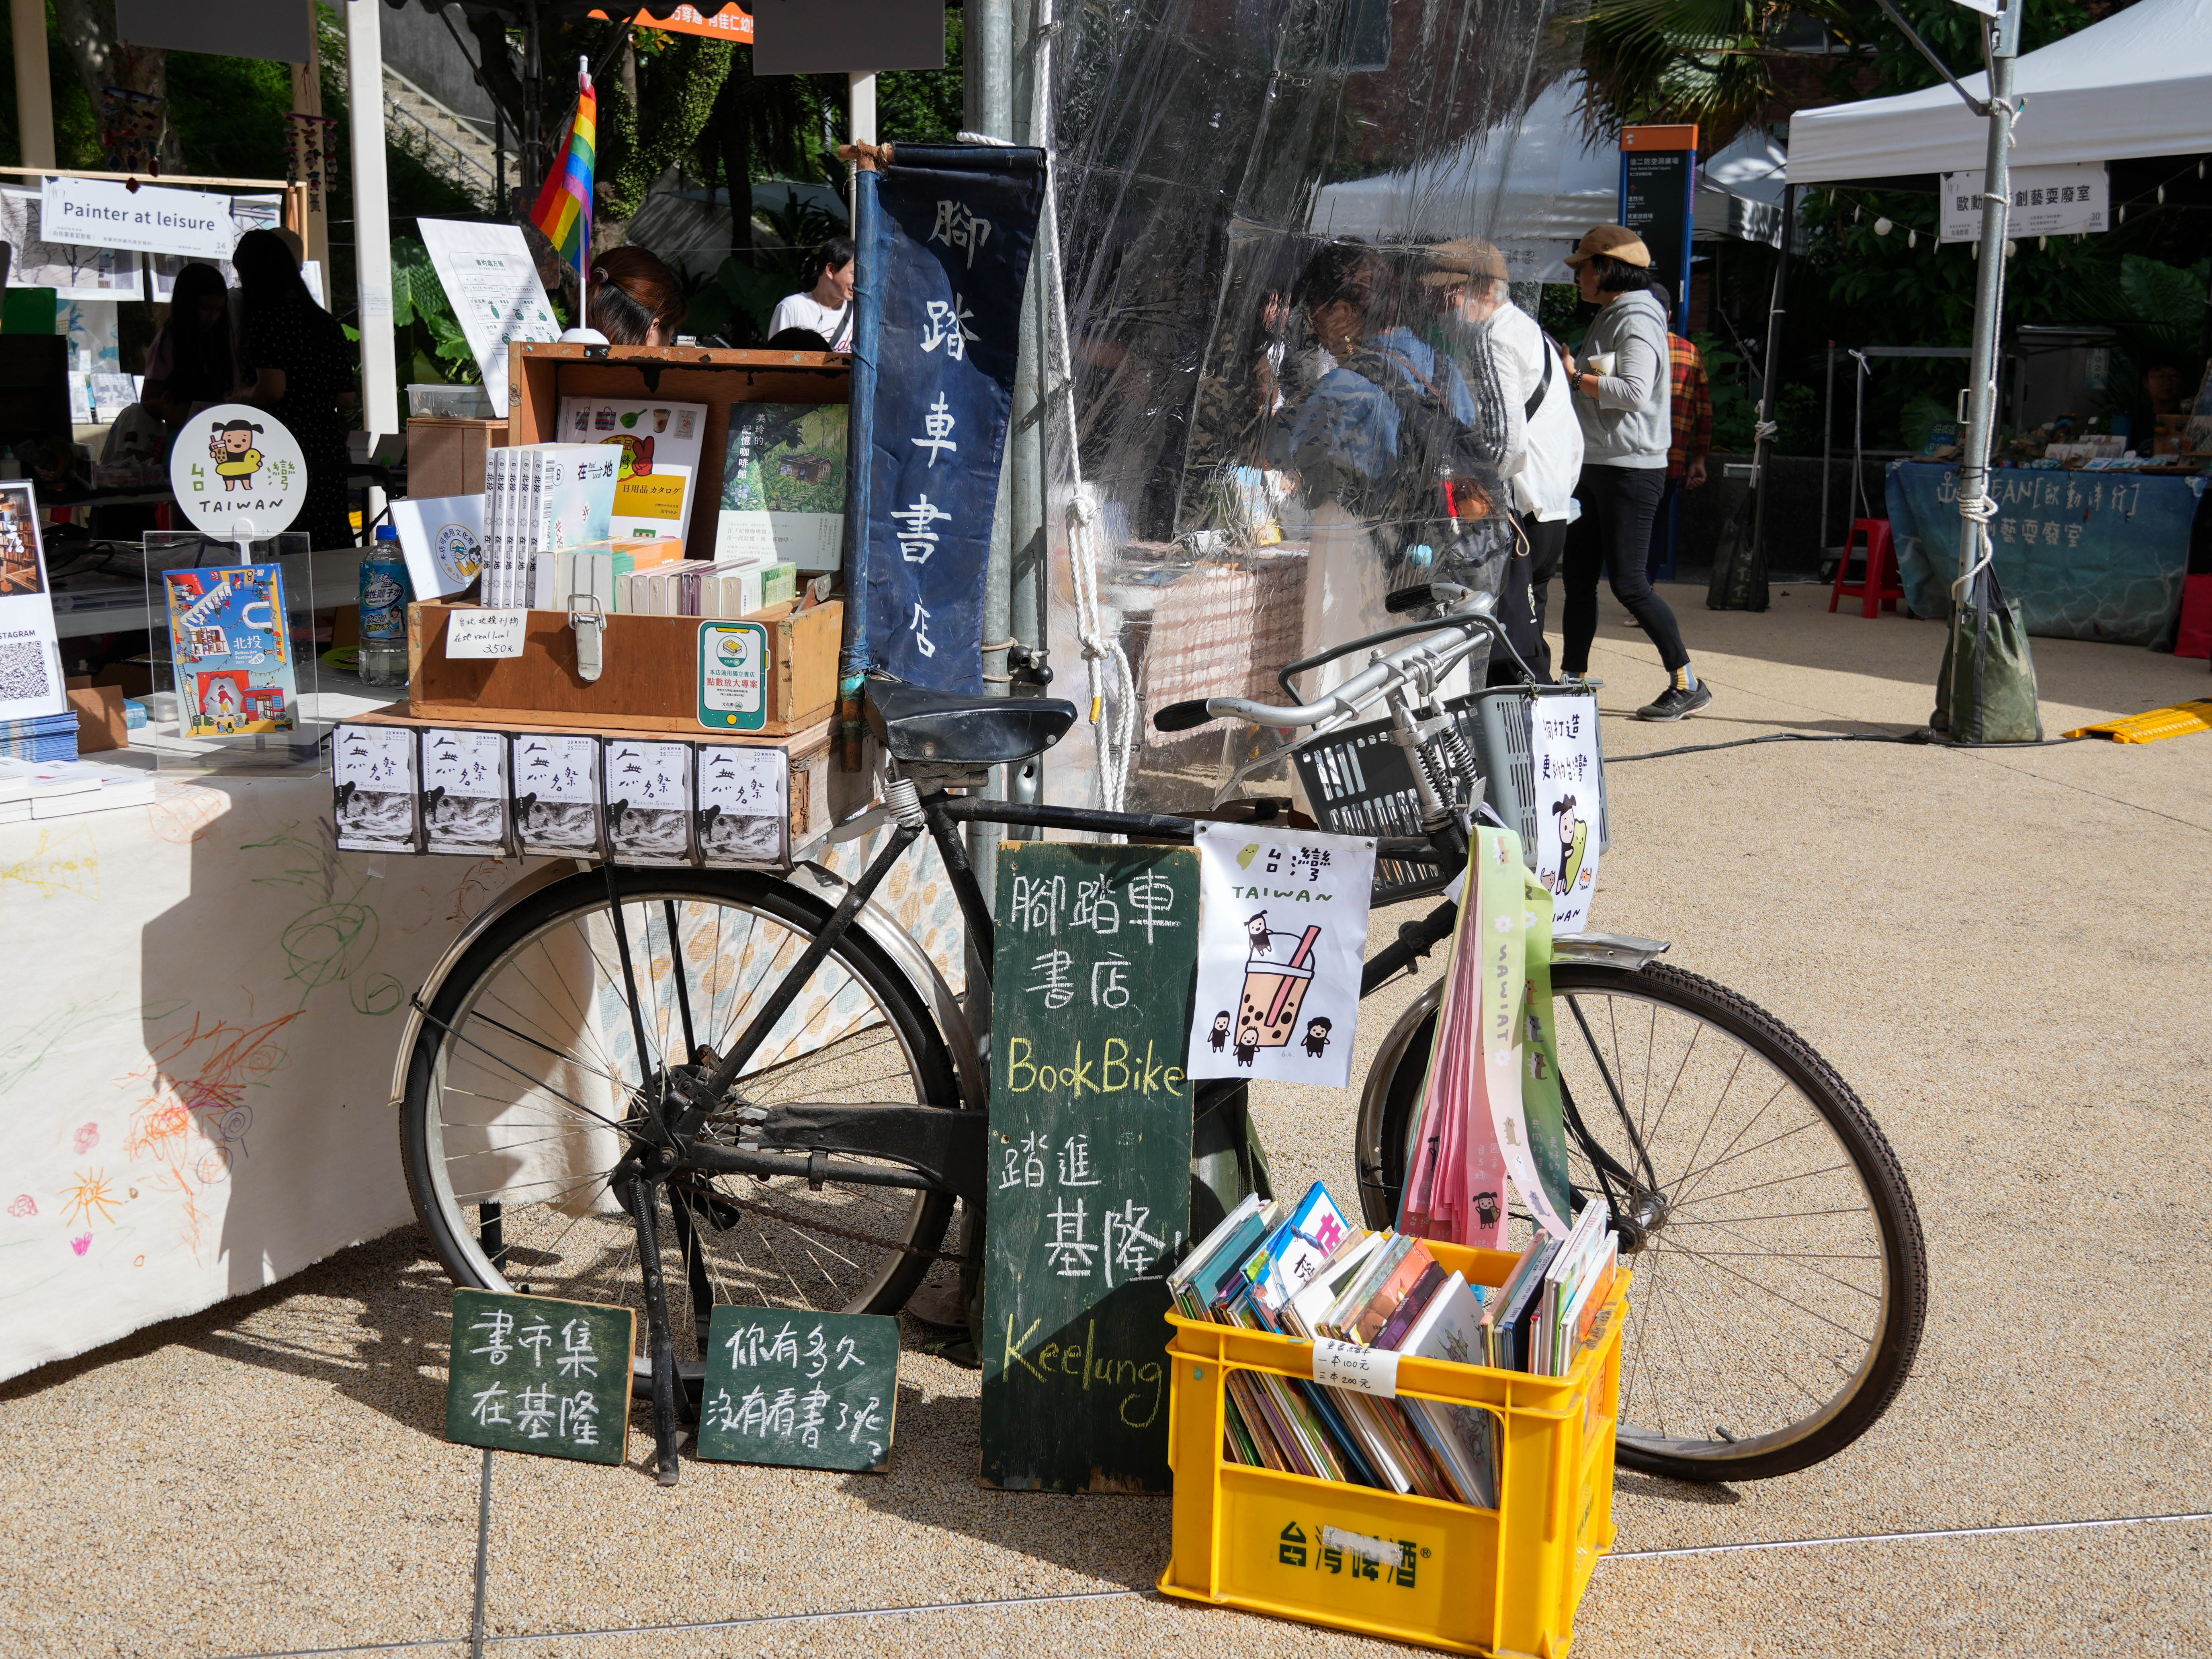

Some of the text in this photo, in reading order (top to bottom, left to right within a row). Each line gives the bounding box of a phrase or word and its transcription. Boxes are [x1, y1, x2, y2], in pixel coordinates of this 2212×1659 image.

[1956, 185, 2090, 212] 歐勳創藝耍廢室
[64, 202, 215, 231] Painter at leisure
[2090, 212, 2100, 221] 30
[754, 414, 766, 446] 美玲的
[891, 199, 992, 658] 腳踏車書店
[737, 425, 752, 479] 記憶咖啡館
[556, 469, 561, 480] B
[578, 459, 613, 481] 在 地
[592, 471, 602, 479] Local
[486, 473, 494, 492] 北投
[497, 473, 505, 492] 北投
[510, 473, 516, 492] 北投
[522, 473, 529, 492] 北投
[534, 475, 541, 494] 北投
[623, 484, 681, 495] 日用品 カタログ
[199, 499, 283, 513] TAIWAN
[484, 535, 491, 544] 在
[495, 535, 502, 544] 在
[507, 536, 514, 545] 在
[519, 537, 526, 545] 在
[530, 537, 537, 546] 在
[483, 561, 491, 570] 地
[494, 561, 501, 570] 地
[506, 561, 512, 571] 地
[518, 561, 525, 571] 地
[530, 563, 537, 572] 地
[377, 572, 395, 588] 舒跑
[233, 635, 263, 649] 北投
[475, 631, 490, 640] real
[483, 644, 514, 653] 350元
[709, 669, 755, 678] 本店適用獨立書店
[707, 678, 758, 688] 點數放大專案
[1265, 846, 1331, 882] 台灣
[1231, 885, 1334, 901] TAIWAN
[1010, 867, 1182, 945] 腳踏車
[1552, 909, 1580, 924] IWAN
[1026, 948, 1132, 1010] 書店
[998, 1131, 1102, 1190] 踏進
[468, 1309, 600, 1378] 書市集
[725, 1320, 865, 1379] 你有多久
[1002, 1313, 1163, 1428] Keelung
[470, 1380, 600, 1445] 在基隆
